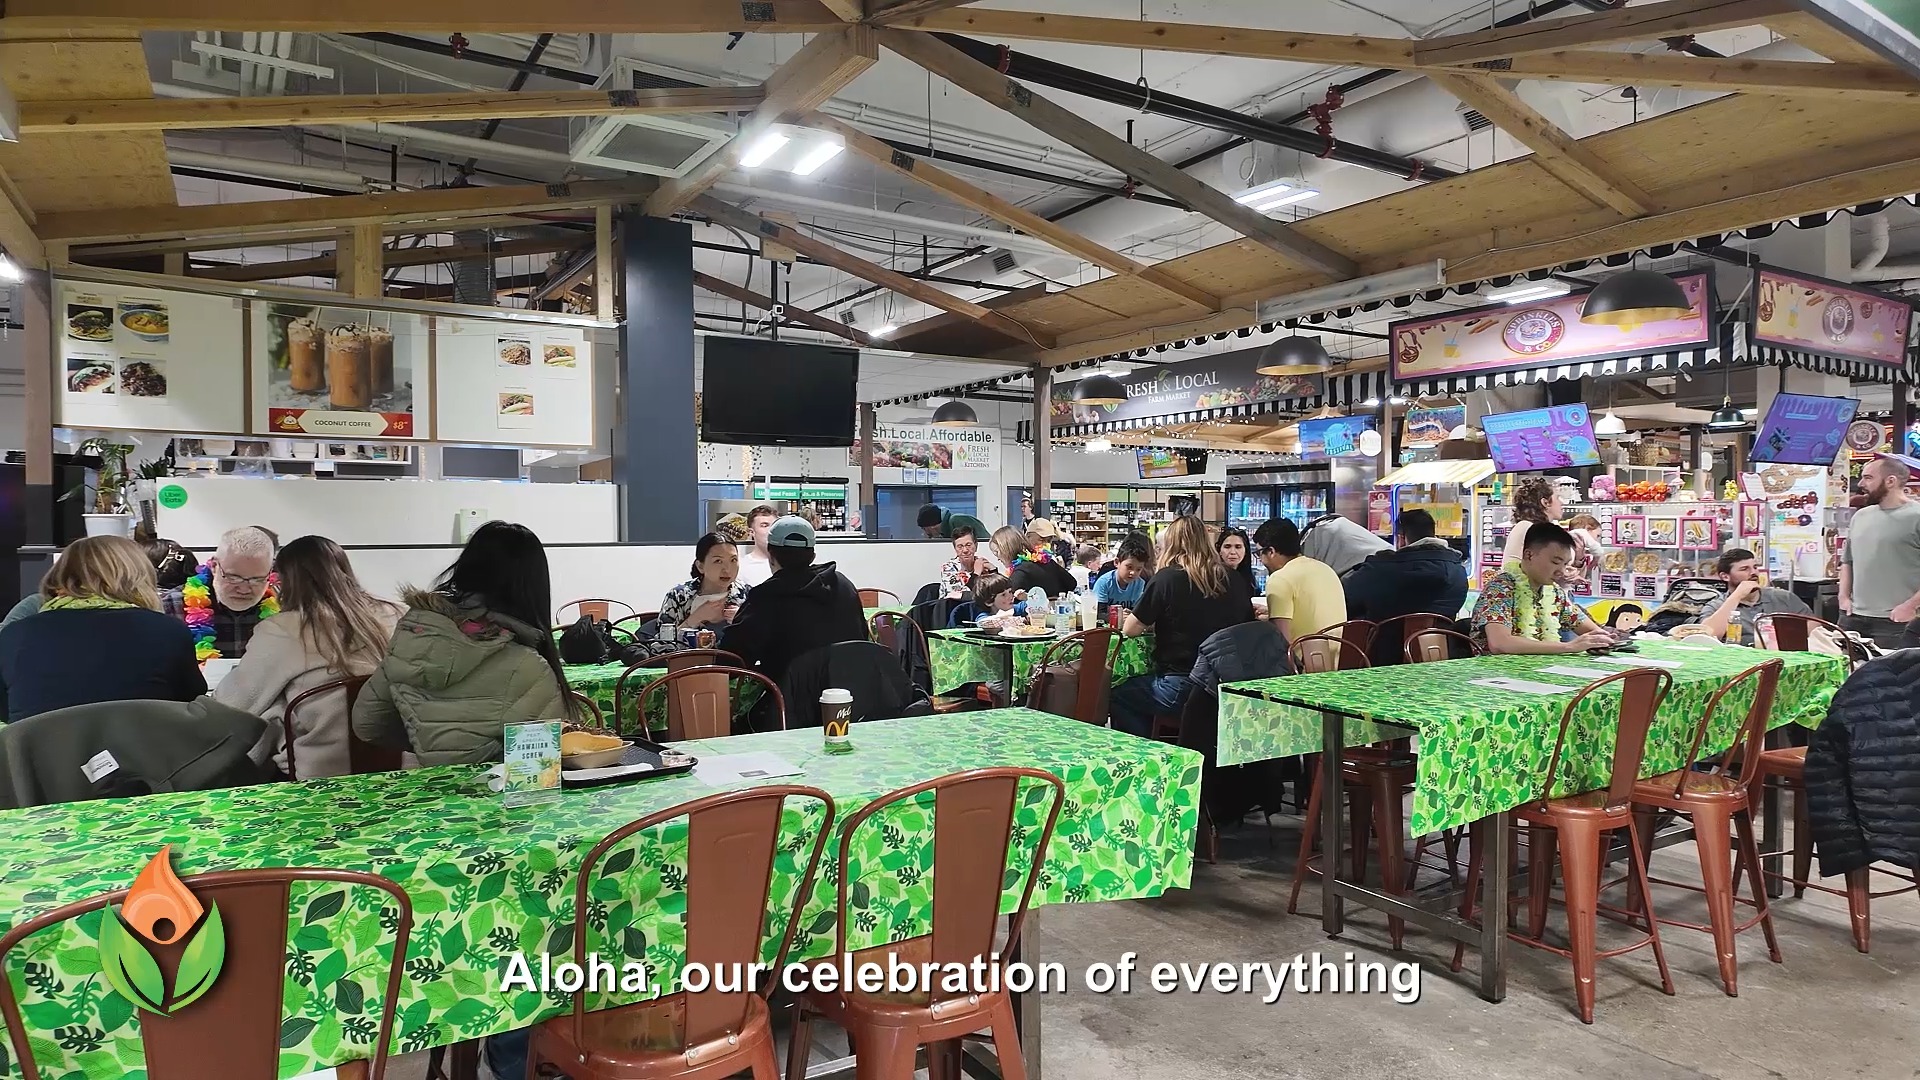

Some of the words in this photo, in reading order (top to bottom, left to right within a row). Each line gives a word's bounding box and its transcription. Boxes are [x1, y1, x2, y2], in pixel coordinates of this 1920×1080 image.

[1507, 312, 1561, 334] SPRINKLES
[1176, 371, 1219, 390] LOCAL
[1148, 396, 1165, 404] FARM
[1166, 392, 1191, 402] MARKET
[314, 419, 347, 427] COCONUT
[348, 420, 372, 428] COFFEE
[855, 425, 995, 443] sh.Local.Affordable.
[967, 444, 990, 453] FRESH
[517, 742, 548, 751] HAWAIIAN
[522, 752, 544, 760] SCREW
[527, 775, 538, 784] $8
